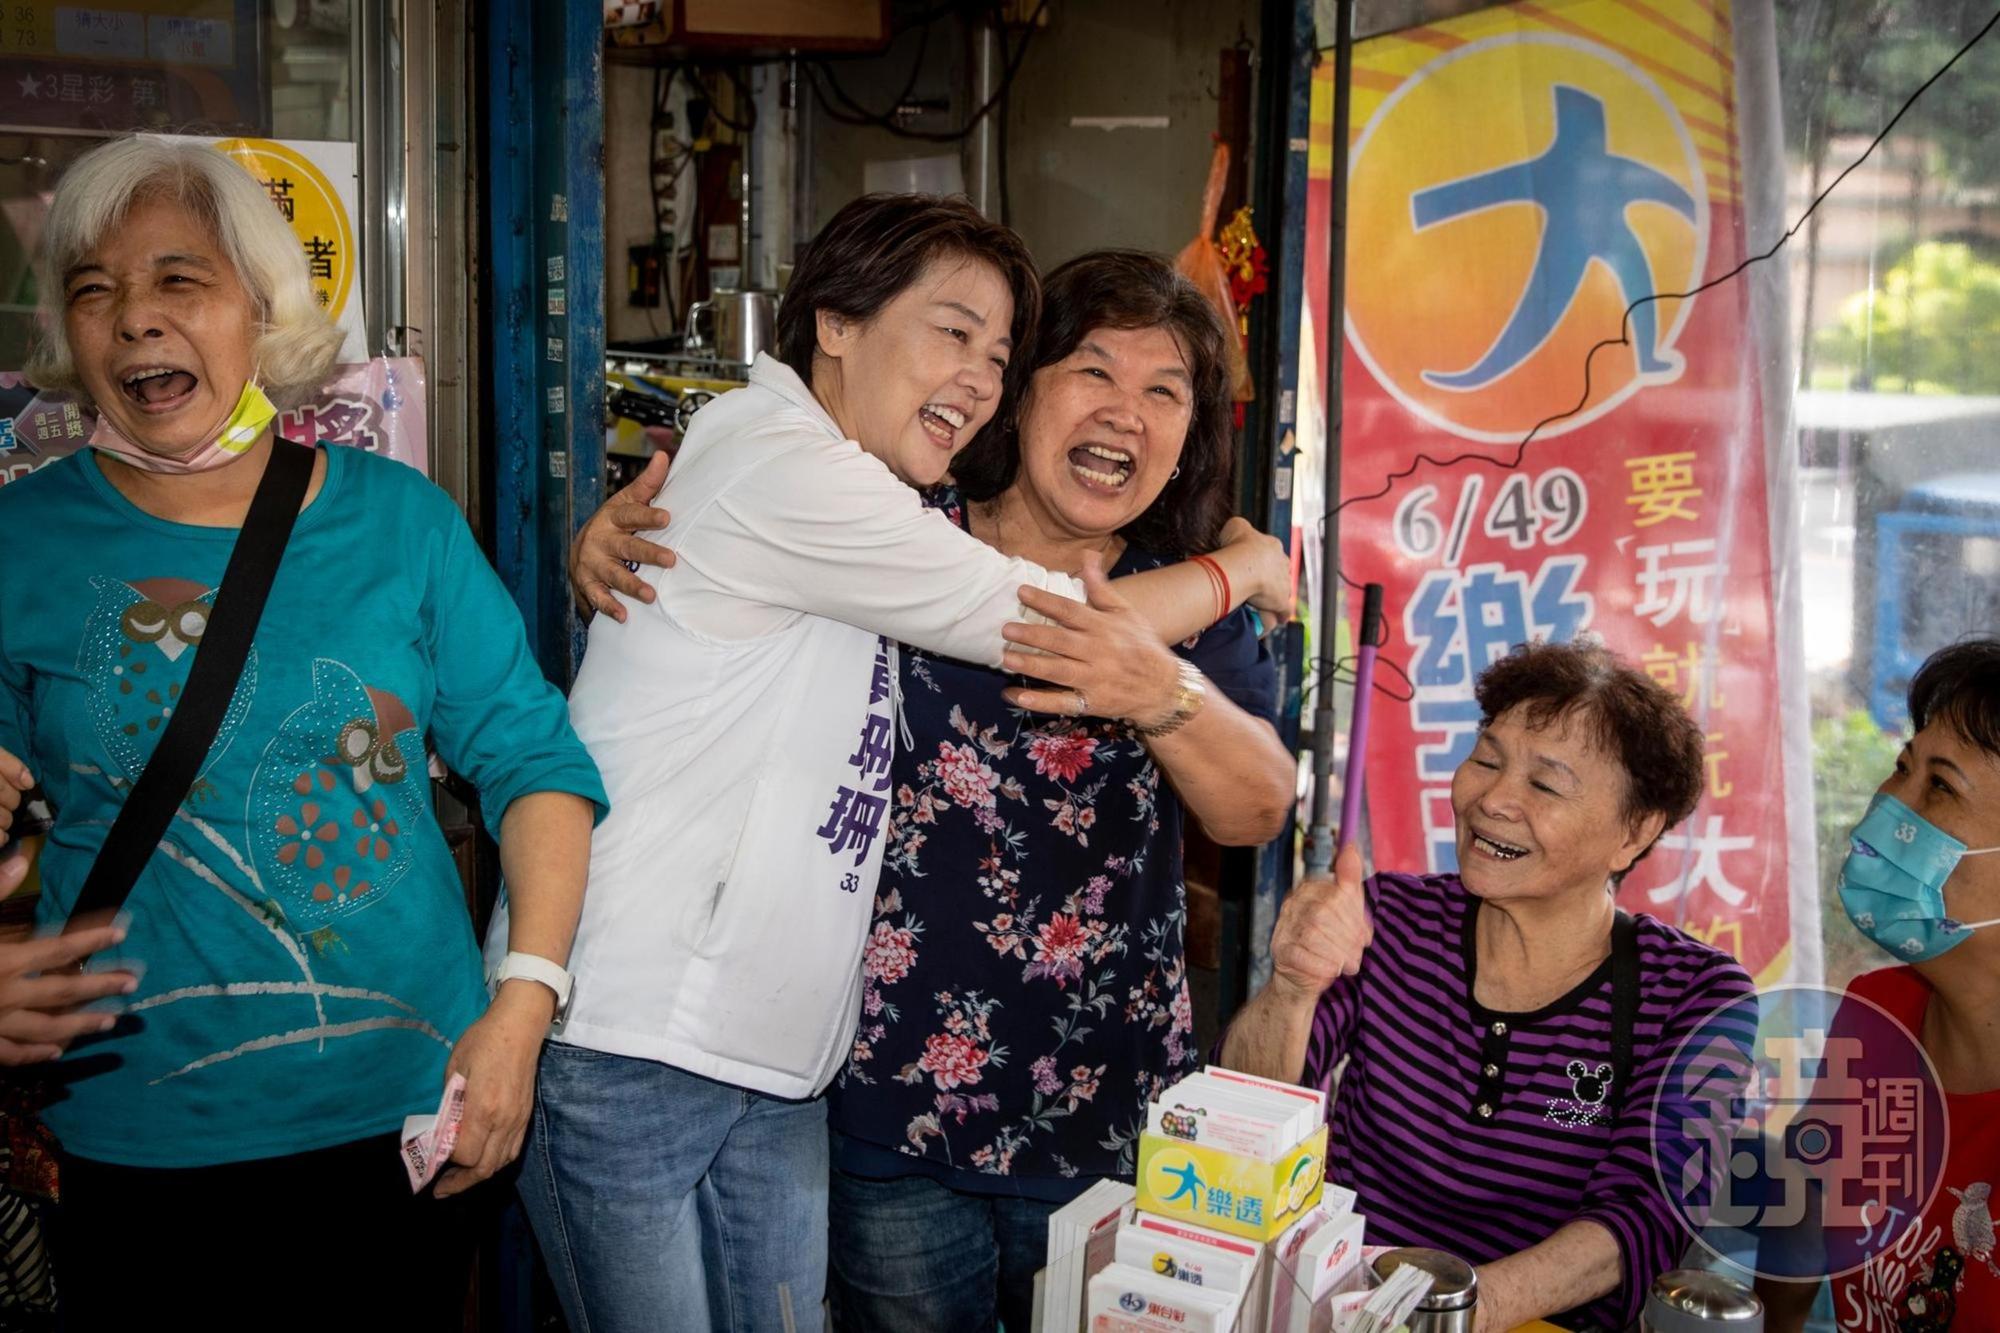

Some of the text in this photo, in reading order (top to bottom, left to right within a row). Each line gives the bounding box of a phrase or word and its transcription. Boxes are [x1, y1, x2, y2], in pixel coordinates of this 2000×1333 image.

[46, 72, 114, 103] 3星彩
[304, 236, 337, 280] 者
[1395, 469, 1588, 565] 6/49
[840, 872, 860, 893] 33
[1856, 1199, 1942, 1268] STOP
[1863, 1251, 1906, 1303] AND
